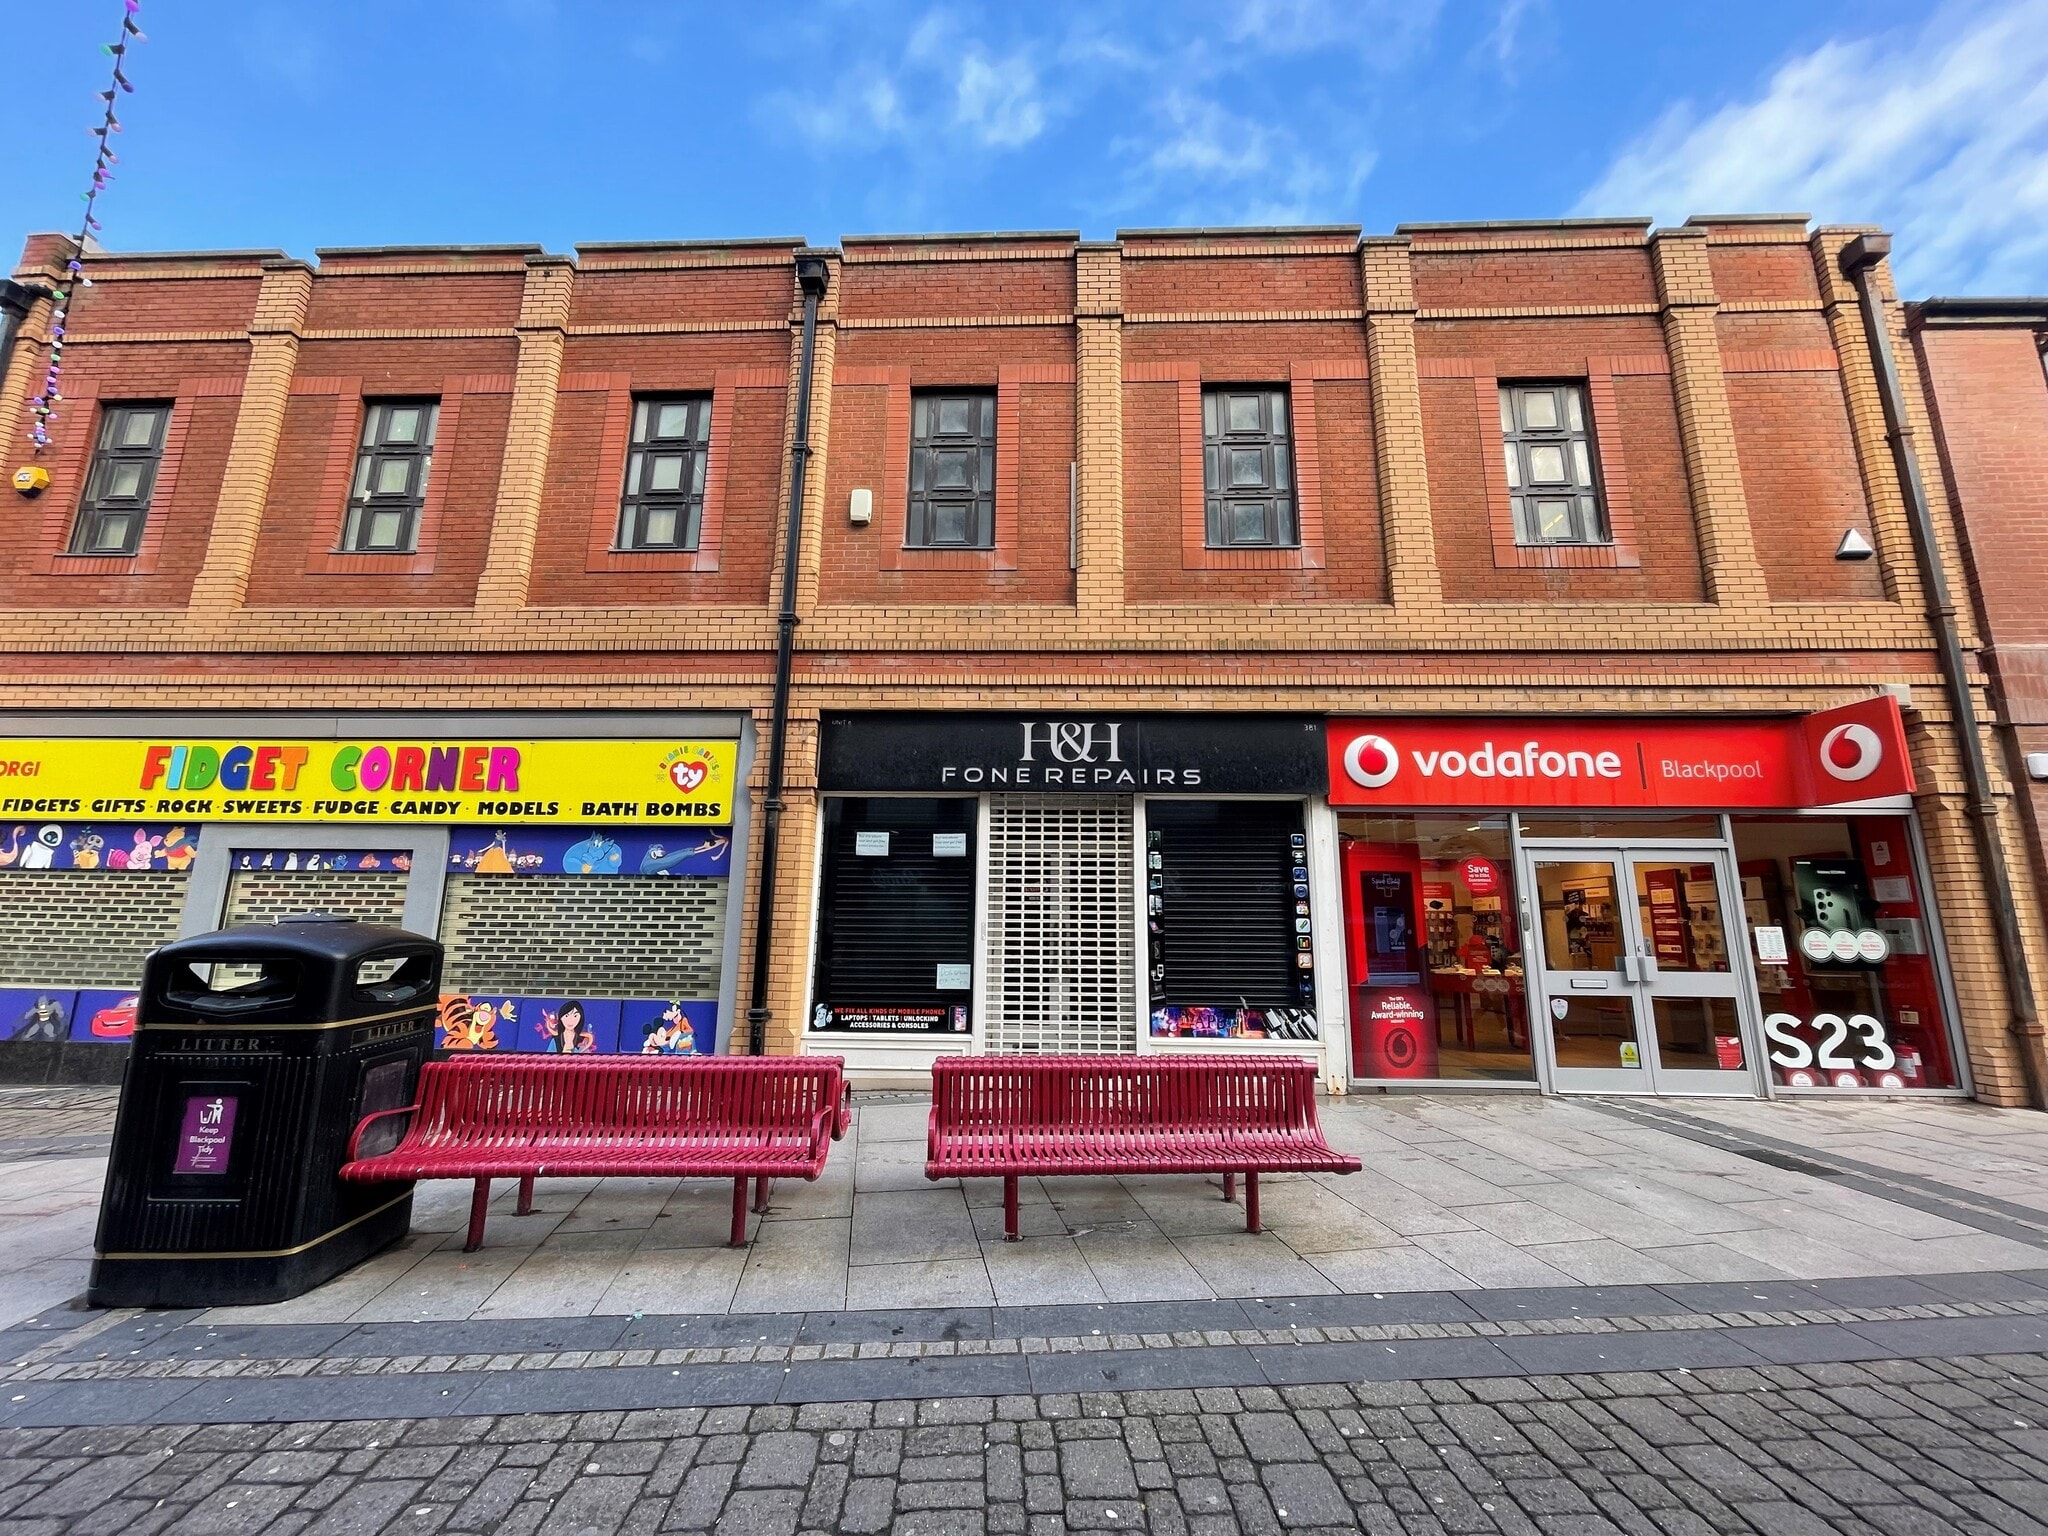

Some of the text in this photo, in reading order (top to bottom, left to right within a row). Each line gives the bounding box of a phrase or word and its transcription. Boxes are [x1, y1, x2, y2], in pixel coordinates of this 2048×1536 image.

[1019, 722, 1123, 763] H&H
[139, 745, 521, 792] FIDGET CORNER
[1411, 741, 1622, 778] vodafone
[672, 763, 703, 788] ty
[941, 767, 1202, 786] FONE REPAIRS
[1661, 760, 1764, 783] Blackpool
[2, 799, 721, 817] FIDGETS GIFTS ROCK SWEETS FUDGE CANDY MODELS BATH BOMBS
[1467, 864, 1490, 873] Save
[1381, 1001, 1413, 1010] Reliable,
[1370, 1010, 1424, 1020] Award-winning
[368, 1021, 415, 1040] LITTER
[180, 1038, 261, 1051] LITTER
[1764, 1013, 1896, 1070] S23
[189, 1135, 226, 1144] Blackpool
[199, 1126, 219, 1135] Keep
[198, 1145, 214, 1155] Tidy
